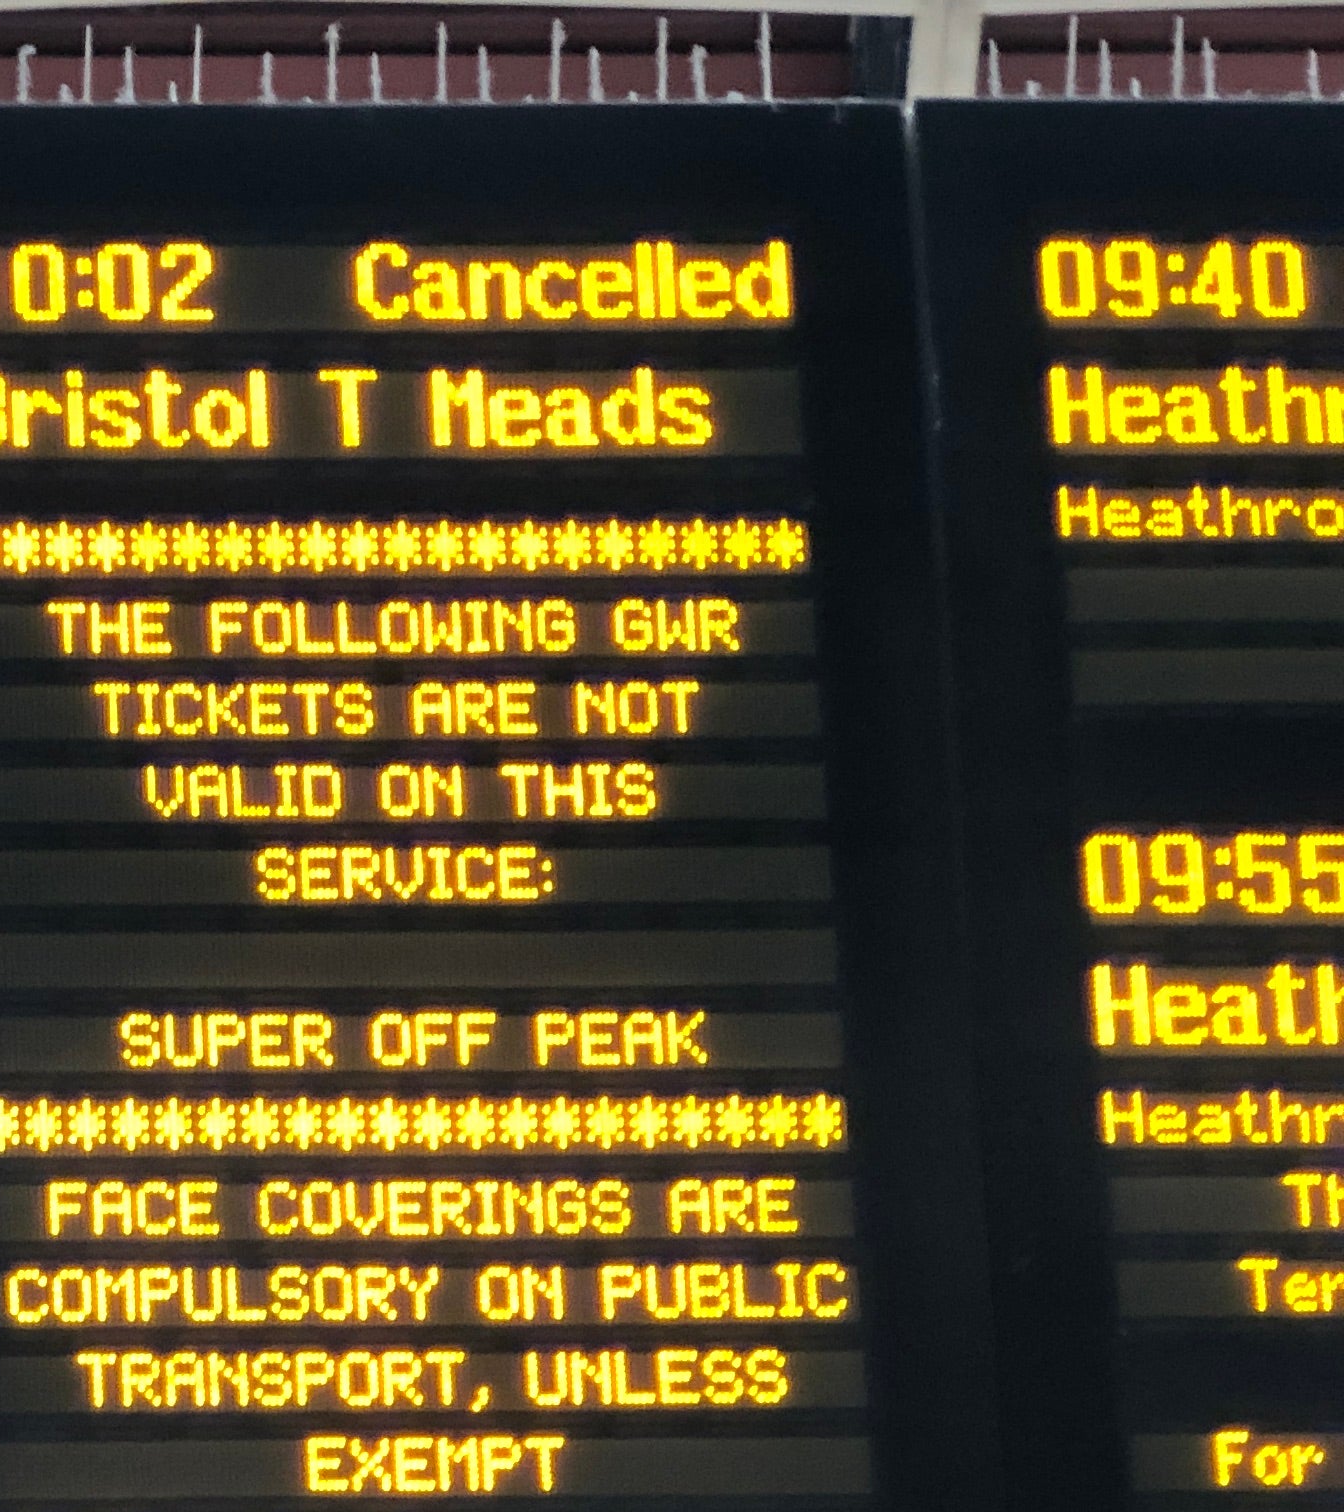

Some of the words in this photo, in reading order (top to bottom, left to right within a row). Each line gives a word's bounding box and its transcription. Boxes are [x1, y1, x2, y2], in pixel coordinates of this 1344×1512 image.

[353, 239, 792, 322] Cancelled
[1039, 239, 1308, 320] 09:40
[317, 368, 379, 449] T
[428, 366, 714, 450] Meads
[1056, 484, 1344, 539] Heathro
[45, 600, 174, 656] THE
[207, 598, 577, 656] FOLLOWING
[611, 597, 741, 653] GWR
[92, 681, 375, 737] TICKETS
[409, 680, 539, 736] ARE
[573, 679, 701, 736] NOT
[143, 763, 343, 819] VALID
[378, 763, 465, 819] ON
[498, 761, 657, 818] THIS
[254, 845, 554, 902] SERVICE:
[1082, 831, 1344, 916] 09:55
[118, 1012, 335, 1069] SUPER
[369, 1010, 497, 1068] OFF
[533, 1010, 709, 1068] PEAK
[45, 1179, 221, 1237] FACE
[256, 1178, 633, 1239] COVERINGS
[667, 1176, 800, 1235] ARE
[5, 1264, 441, 1325] COMPULSORY
[476, 1264, 566, 1322] ON
[598, 1262, 849, 1321] PUBLIC
[74, 1349, 491, 1414] TRANSPORT,
[523, 1347, 790, 1408] UNLESS
[303, 1434, 566, 1495] EXEMPT
[1211, 1429, 1326, 1488] For
